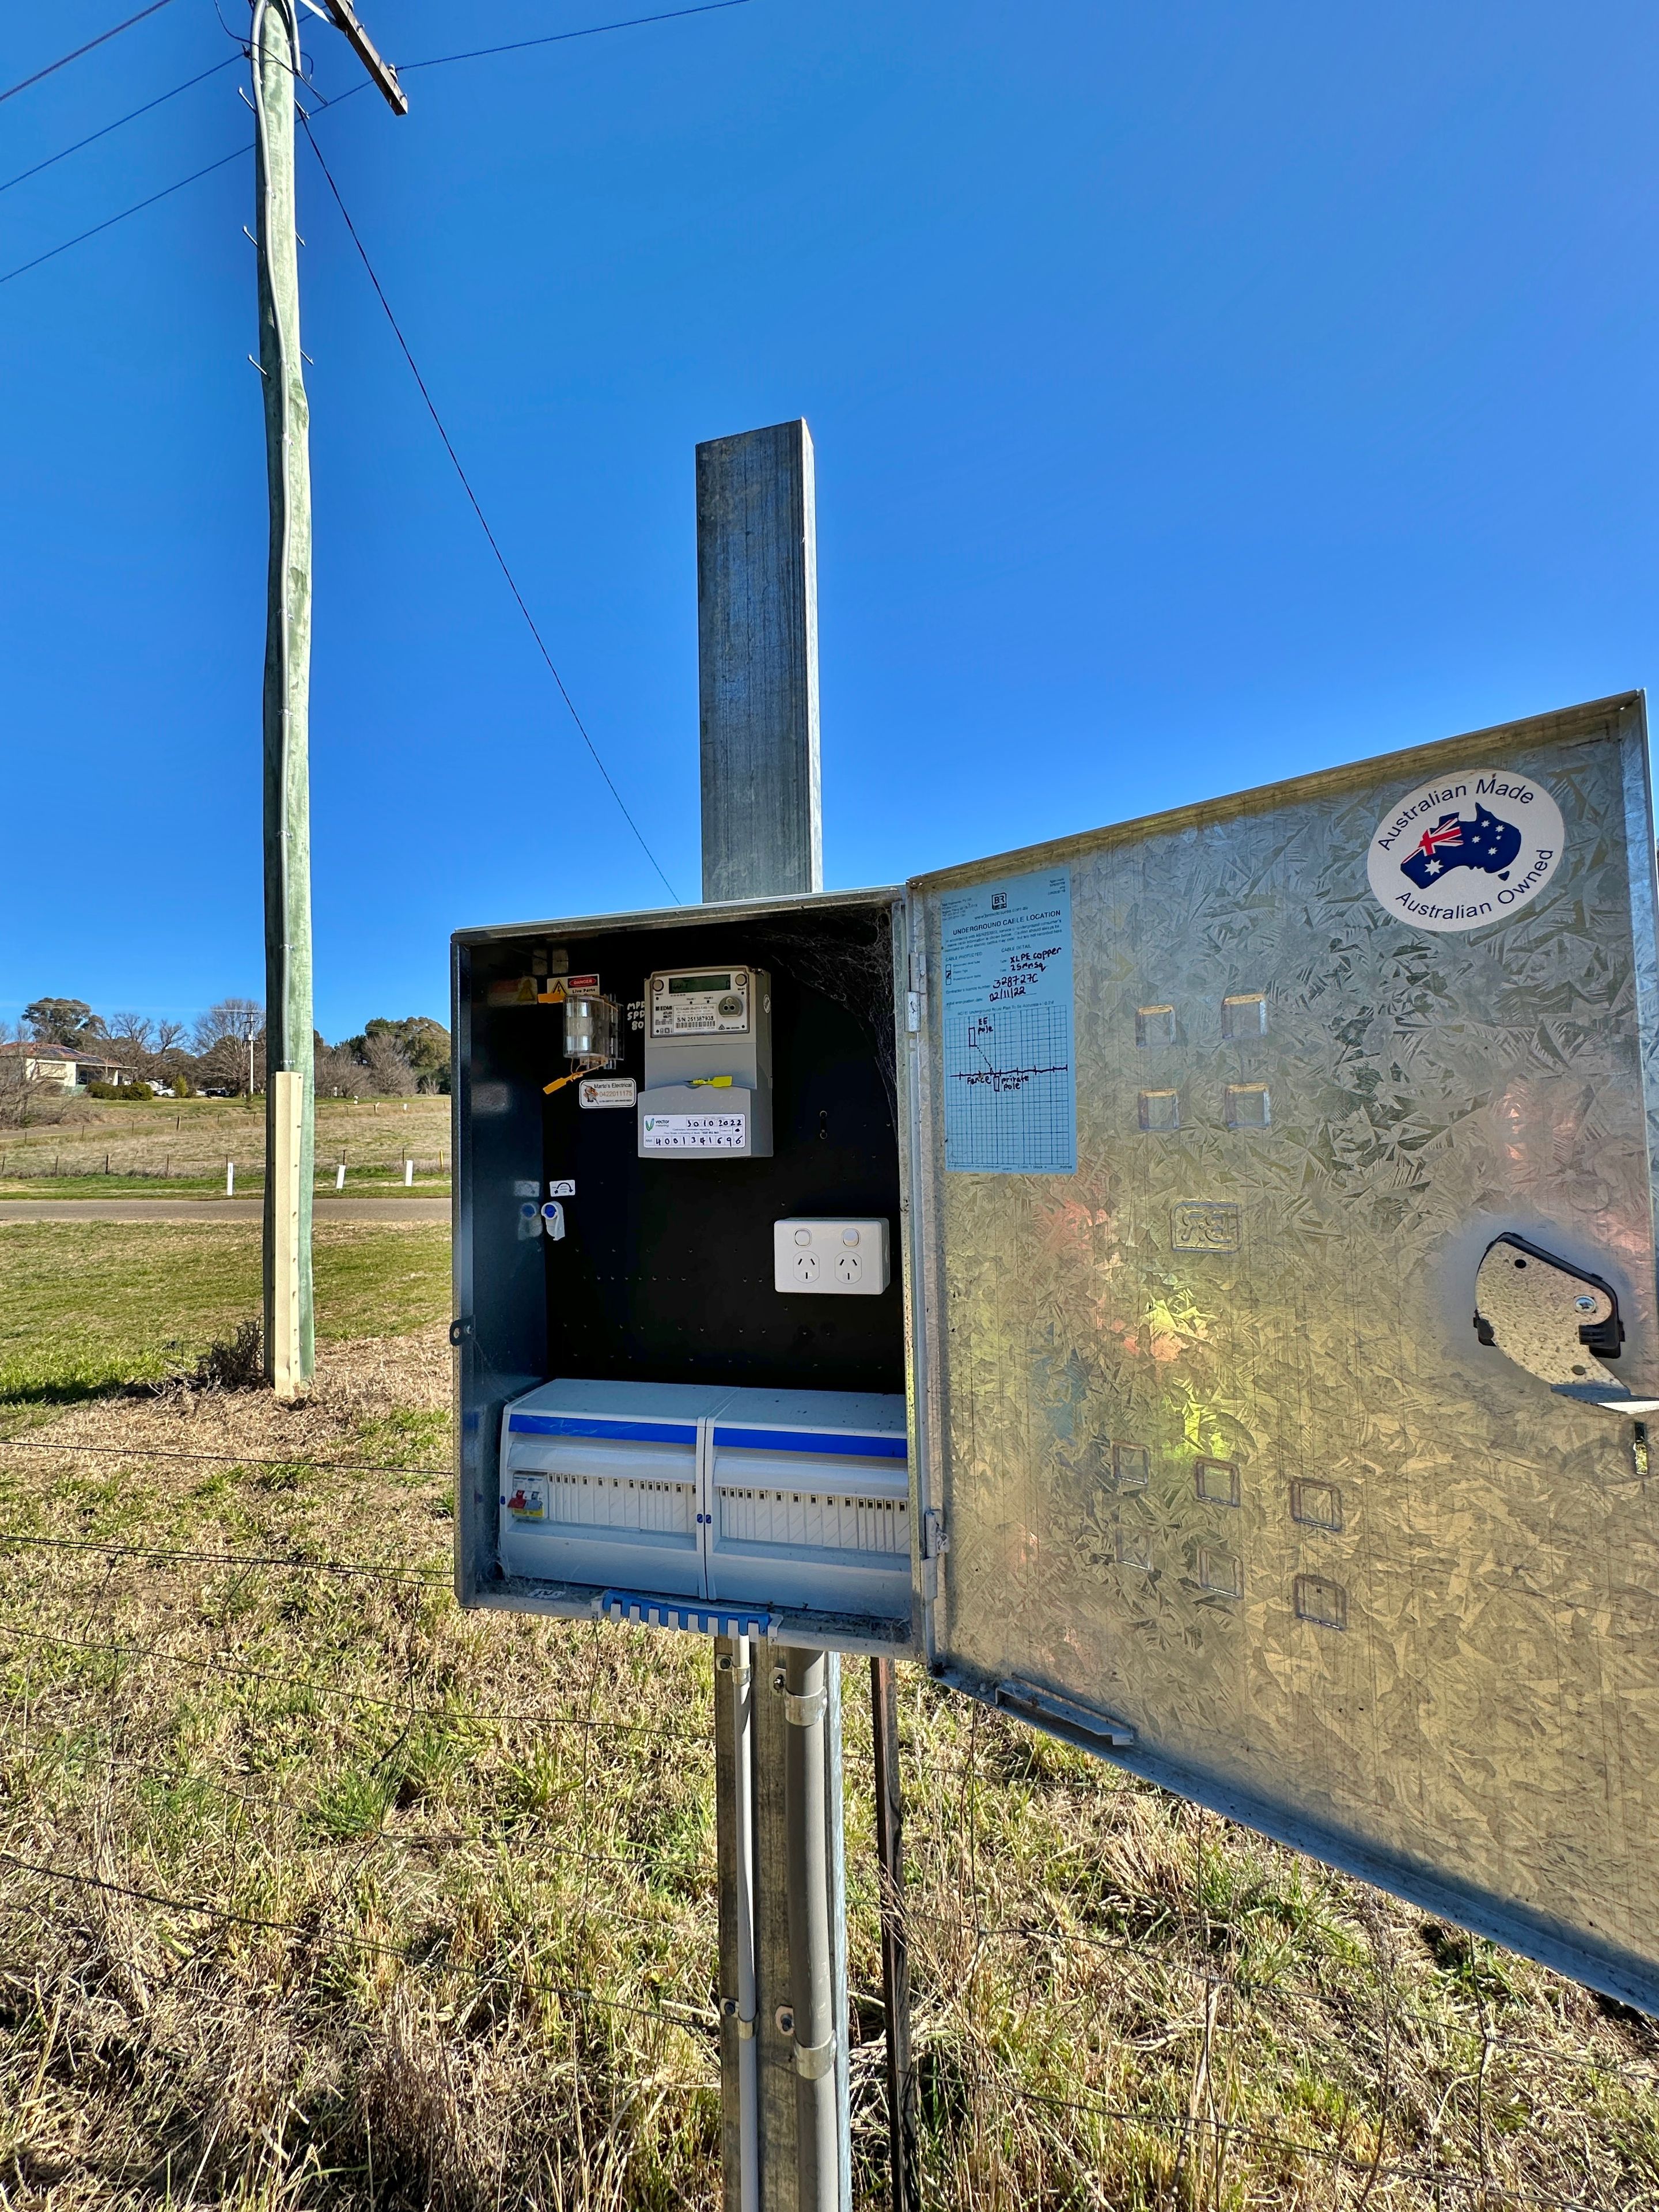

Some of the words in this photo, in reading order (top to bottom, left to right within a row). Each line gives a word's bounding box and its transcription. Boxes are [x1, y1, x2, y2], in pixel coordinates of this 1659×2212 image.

[1378, 786, 1467, 851] Australian
[1476, 778, 1533, 804] Made
[1396, 892, 1492, 919] Australian
[1498, 850, 1554, 904] Owned
[953, 921, 1001, 935] UNDERGROUND
[1003, 916, 1025, 925] CABLE
[1027, 910, 1060, 921] LOCATION
[1010, 952, 1031, 964] XLPE
[993, 973, 1039, 988] 328727C
[989, 986, 1027, 1002] 02/11/22
[631, 1020, 644, 1031] 80
[979, 1016, 988, 1025] EE
[978, 1025, 994, 1036] pole
[967, 1075, 991, 1085] Fence
[1001, 1075, 1029, 1085] private
[1003, 1082, 1021, 1092] pole
